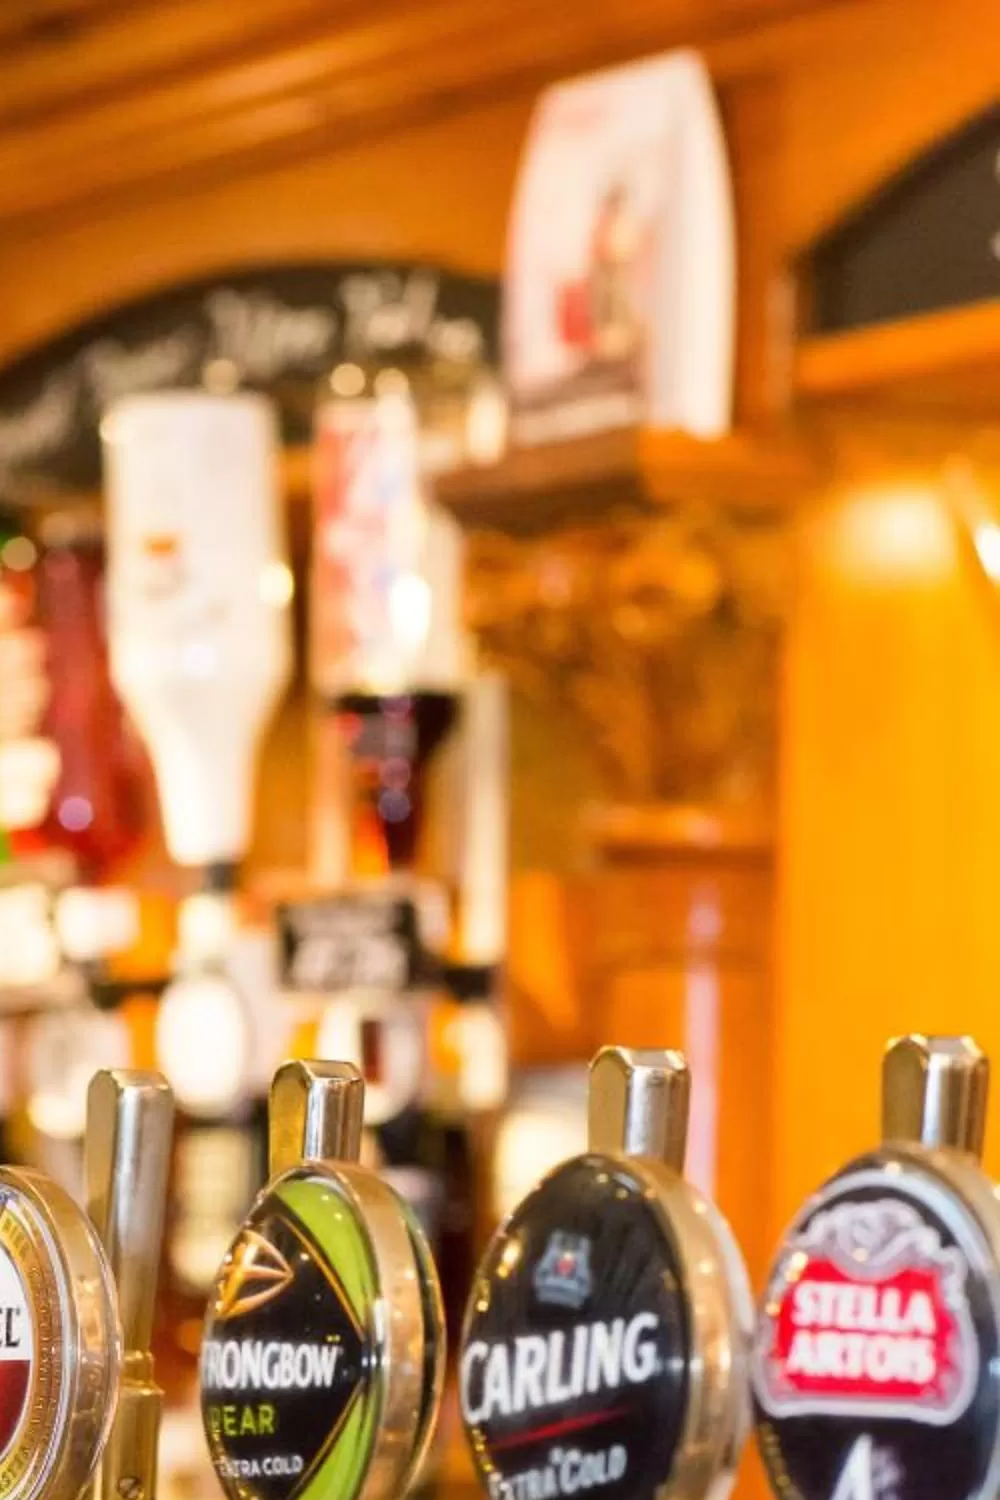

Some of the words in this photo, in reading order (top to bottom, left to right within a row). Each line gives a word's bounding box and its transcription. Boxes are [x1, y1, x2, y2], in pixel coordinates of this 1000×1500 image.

[790, 1281, 937, 1334] STELLA
[460, 1313, 660, 1425] CARLING
[786, 1329, 937, 1383] ARTOIS
[262, 1455, 304, 1476] COLD
[560, 1444, 627, 1494] COLD
